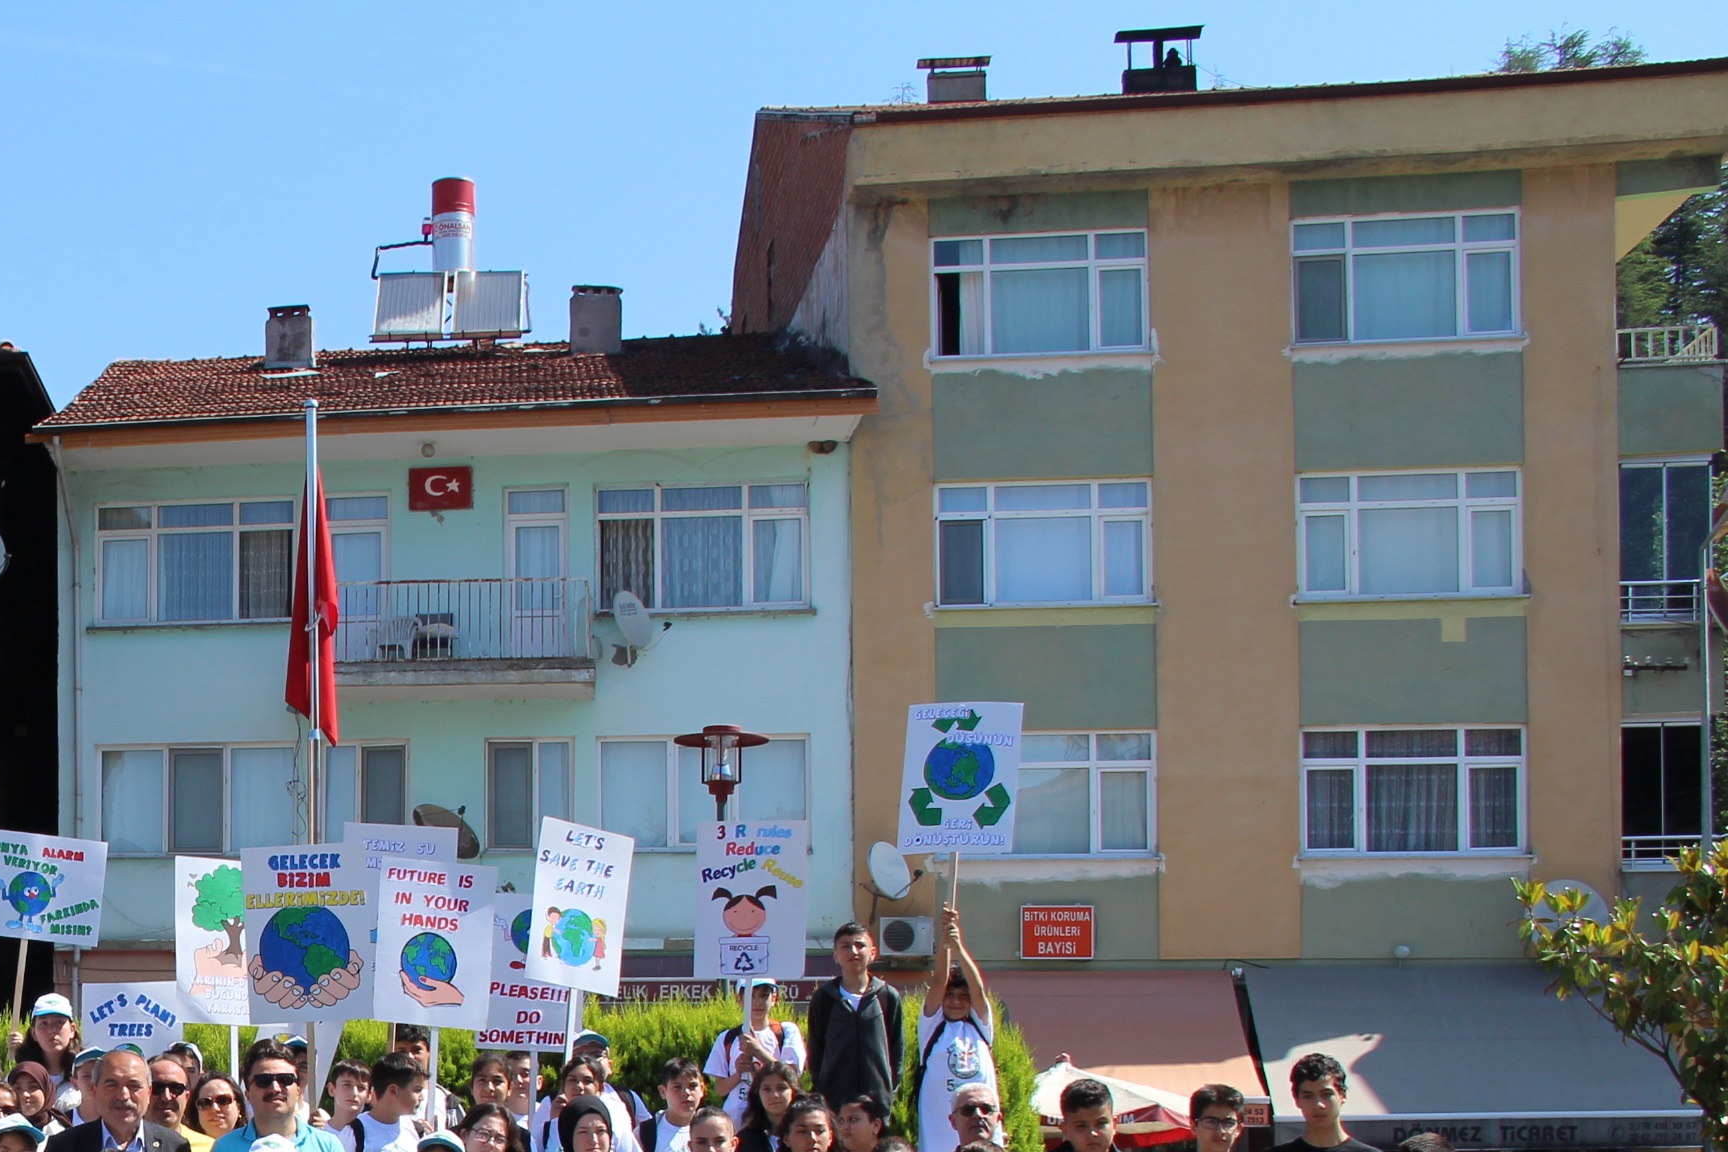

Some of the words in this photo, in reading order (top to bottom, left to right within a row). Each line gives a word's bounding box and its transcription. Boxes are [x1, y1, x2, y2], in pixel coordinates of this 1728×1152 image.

[716, 825, 726, 839] 3
[735, 824, 746, 838] R
[756, 824, 793, 839] rules
[565, 830, 605, 850] LET'S
[42, 847, 84, 861] ALARM
[417, 843, 436, 854] SU
[725, 841, 780, 856] Reduce
[267, 853, 341, 870] GELECEK
[539, 849, 579, 871] SAVE
[586, 860, 614, 877] THE
[387, 867, 446, 885] FUTURE
[458, 875, 474, 889] IS
[701, 858, 756, 883] Recycle
[761, 858, 804, 889] Reuse
[553, 878, 605, 899] EARTH
[394, 892, 412, 904] IN
[424, 895, 469, 912] YOUR
[40, 899, 100, 924] FARKINDA
[1050, 911, 1090, 921] KORUMA
[50, 924, 92, 935] MISIN?
[401, 913, 459, 931] HANDS
[659, 984, 712, 999] ERKEK
[89, 993, 128, 1024] LET'S
[206, 1002, 249, 1015] YARATI
[516, 1011, 541, 1024] DO
[108, 1023, 154, 1037] TREES
[478, 1029, 566, 1045] SOMETHIN
[947, 1079, 954, 1091] 5
[739, 1088, 746, 1099] 5
